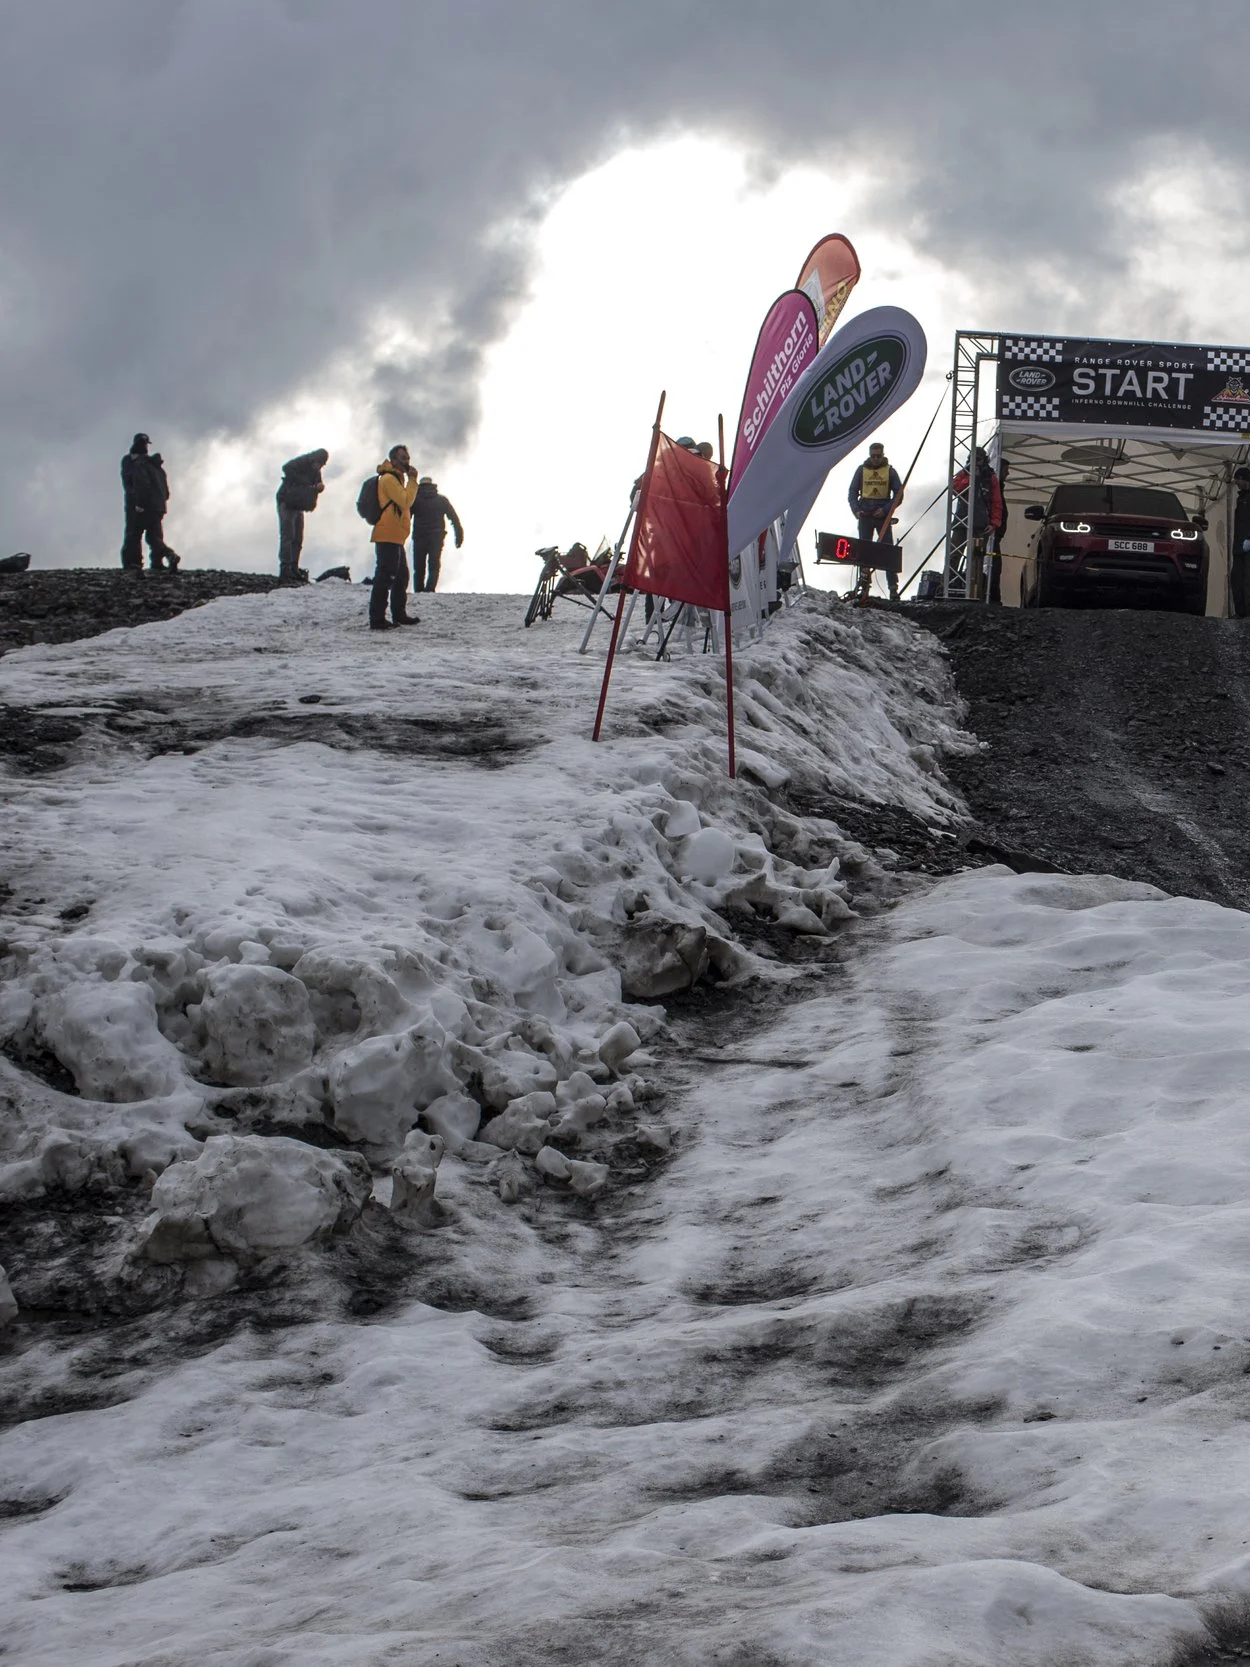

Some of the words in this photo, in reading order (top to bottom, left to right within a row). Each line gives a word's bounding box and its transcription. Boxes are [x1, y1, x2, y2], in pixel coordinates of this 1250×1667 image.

[743, 311, 807, 444] Schilthorn
[780, 374, 793, 399] Piz
[791, 332, 814, 374] Gloria
[1072, 367, 1194, 400] START
[1074, 357, 1111, 365] RANGE
[1117, 359, 1153, 367] ROVER
[1158, 361, 1195, 370] SPORT
[811, 358, 866, 418] LAND
[825, 361, 893, 433] ROVER
[1147, 401, 1192, 410] CHALLENGE
[1114, 541, 1130, 549] SCC
